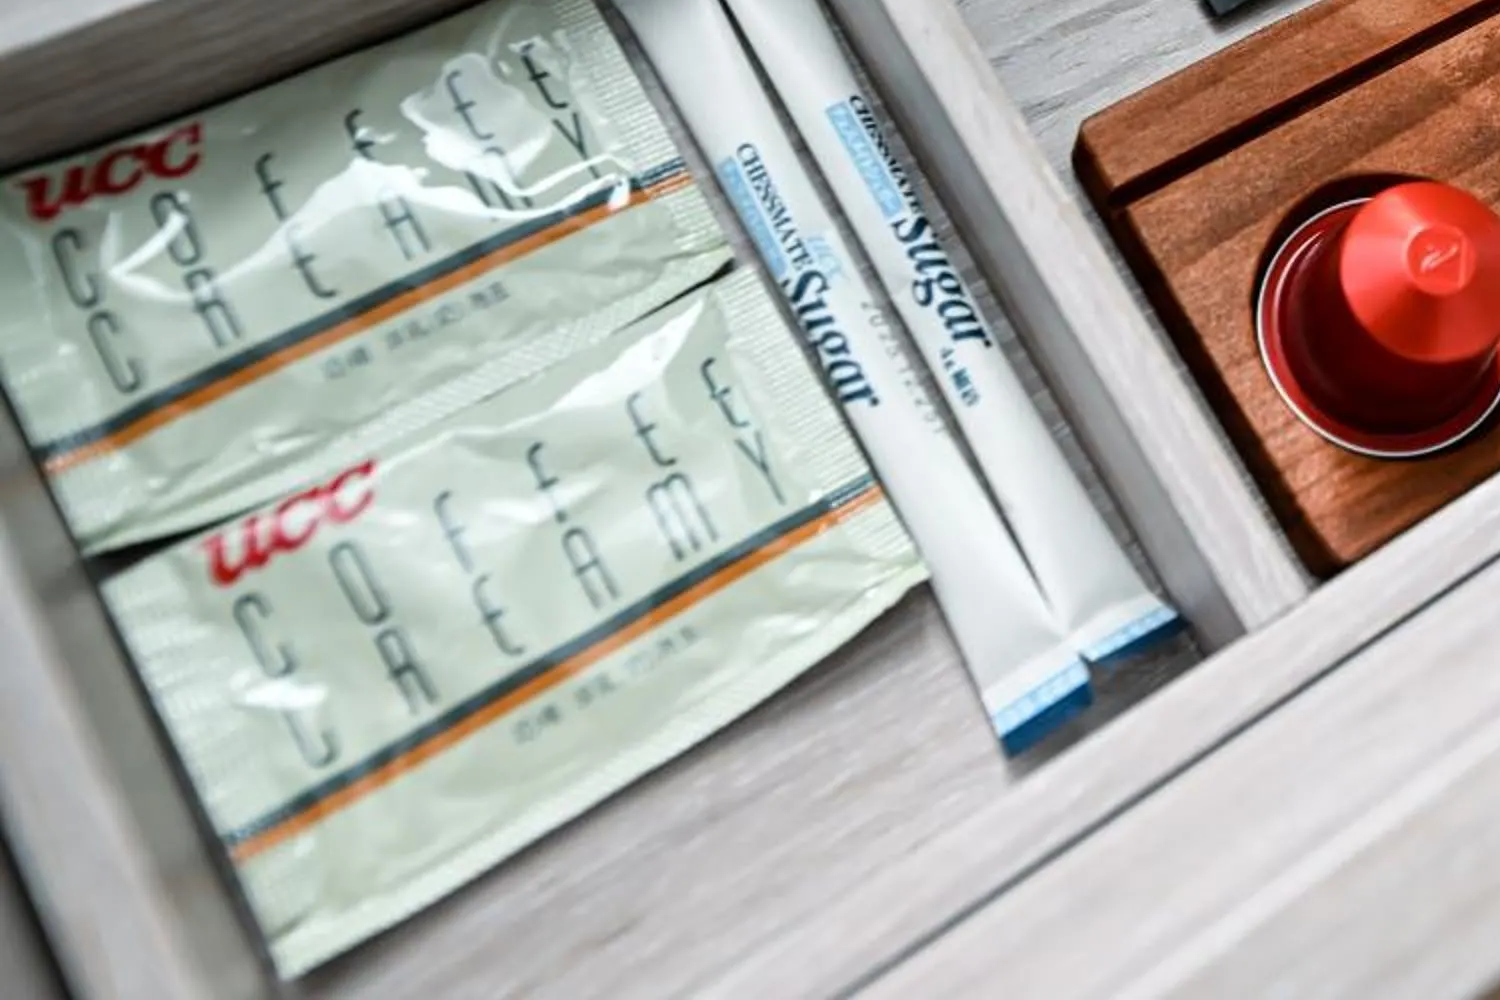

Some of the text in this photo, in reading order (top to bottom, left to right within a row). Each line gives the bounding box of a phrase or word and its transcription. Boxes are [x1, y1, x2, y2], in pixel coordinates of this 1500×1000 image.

[50, 40, 570, 309] COFFEE
[736, 142, 812, 270] CHESSMATE
[780, 270, 880, 408] Sugar
[891, 213, 992, 350] Sugar
[233, 357, 749, 680] COFFEE
